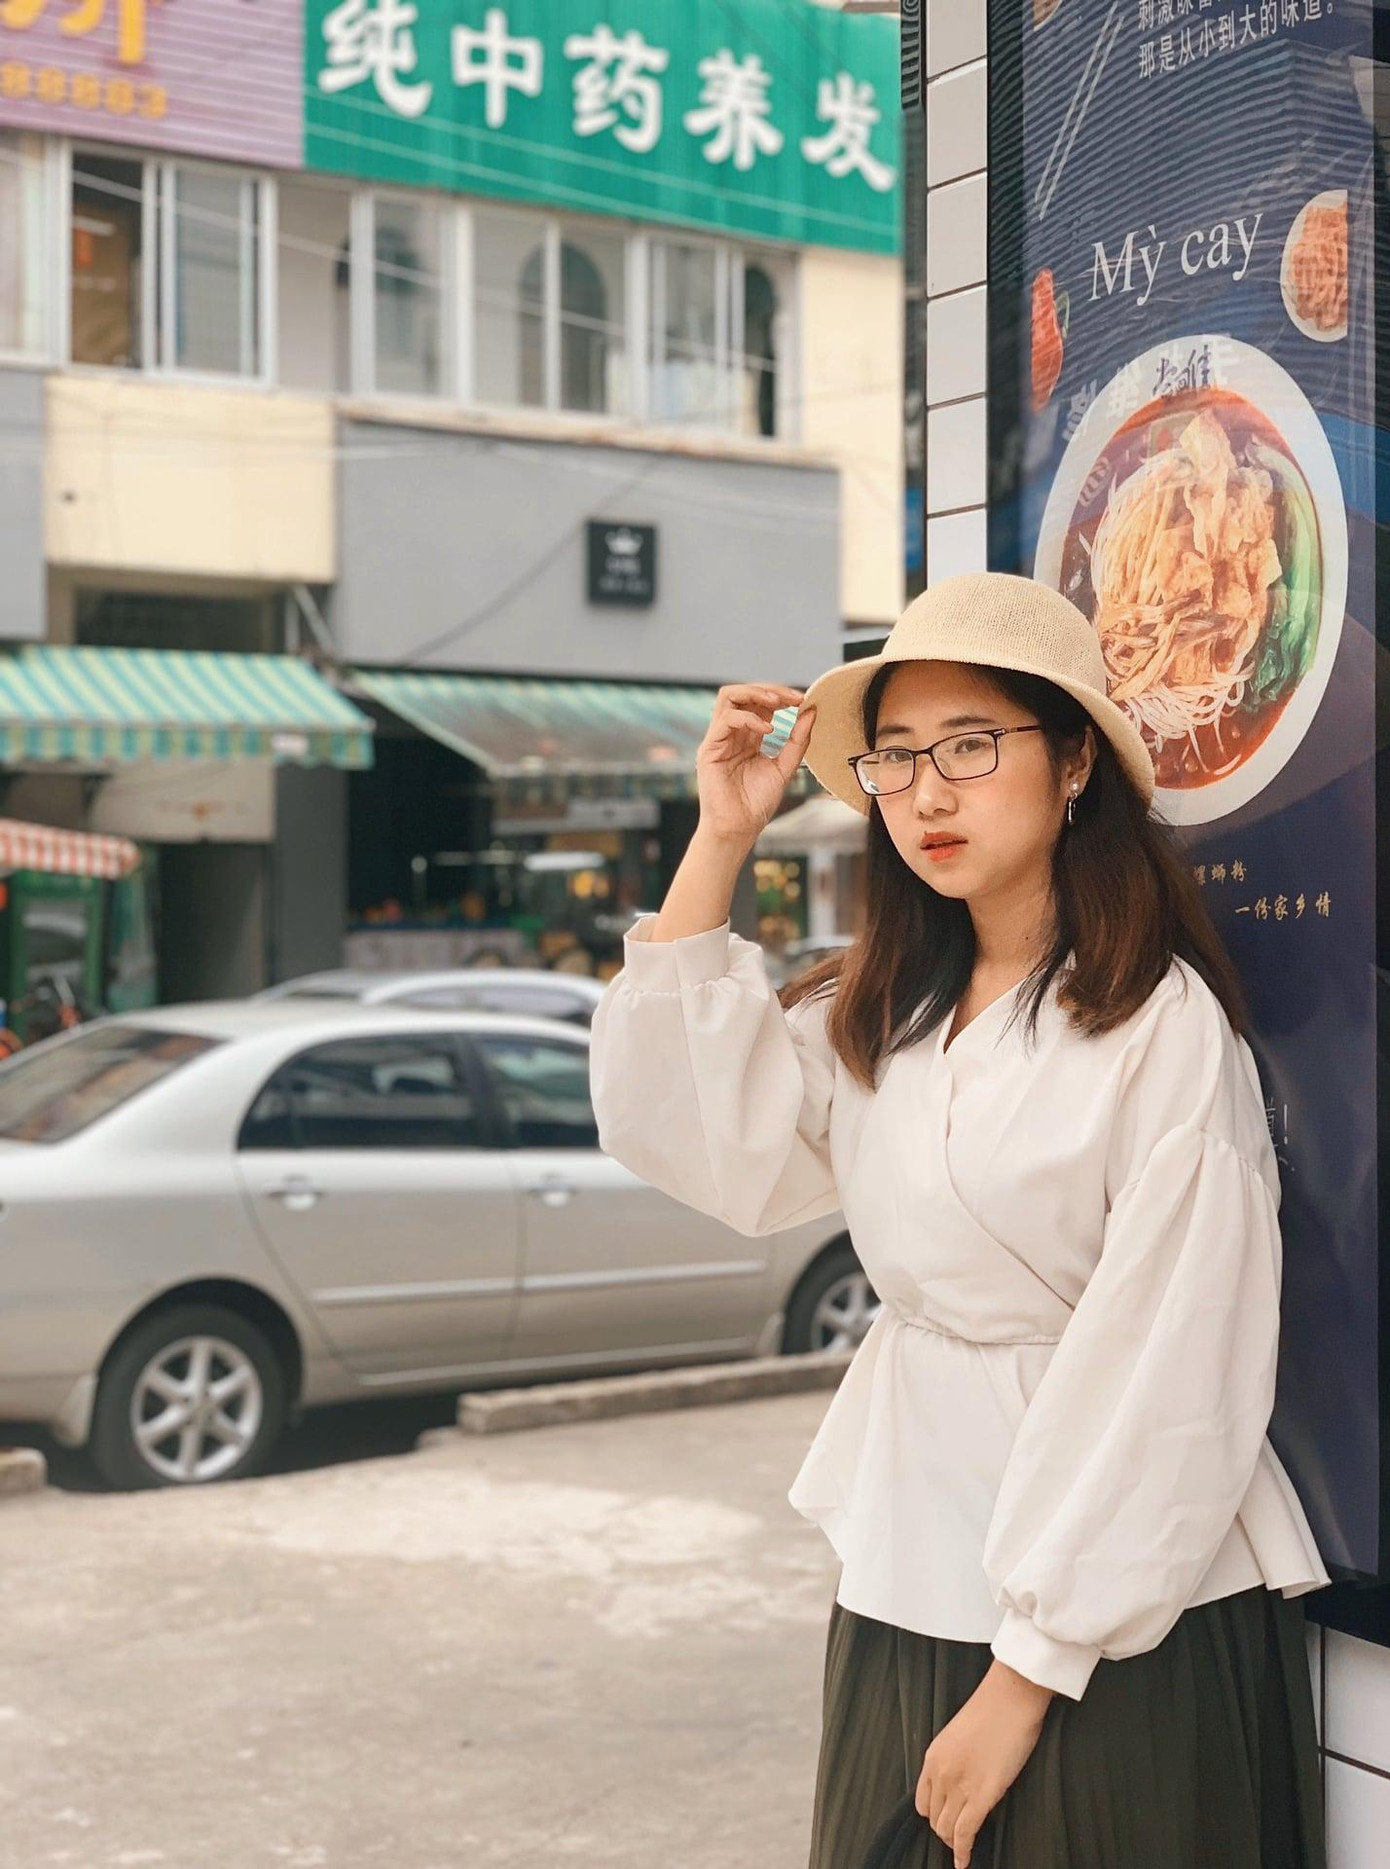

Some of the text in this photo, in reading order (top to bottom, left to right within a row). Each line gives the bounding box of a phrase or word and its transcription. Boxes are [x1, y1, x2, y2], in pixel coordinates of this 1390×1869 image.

[317, 0, 898, 193] 纯中药养发
[1088, 213, 1263, 306] Mỳ cay
[1235, 891, 1332, 921] 一份家乡情
